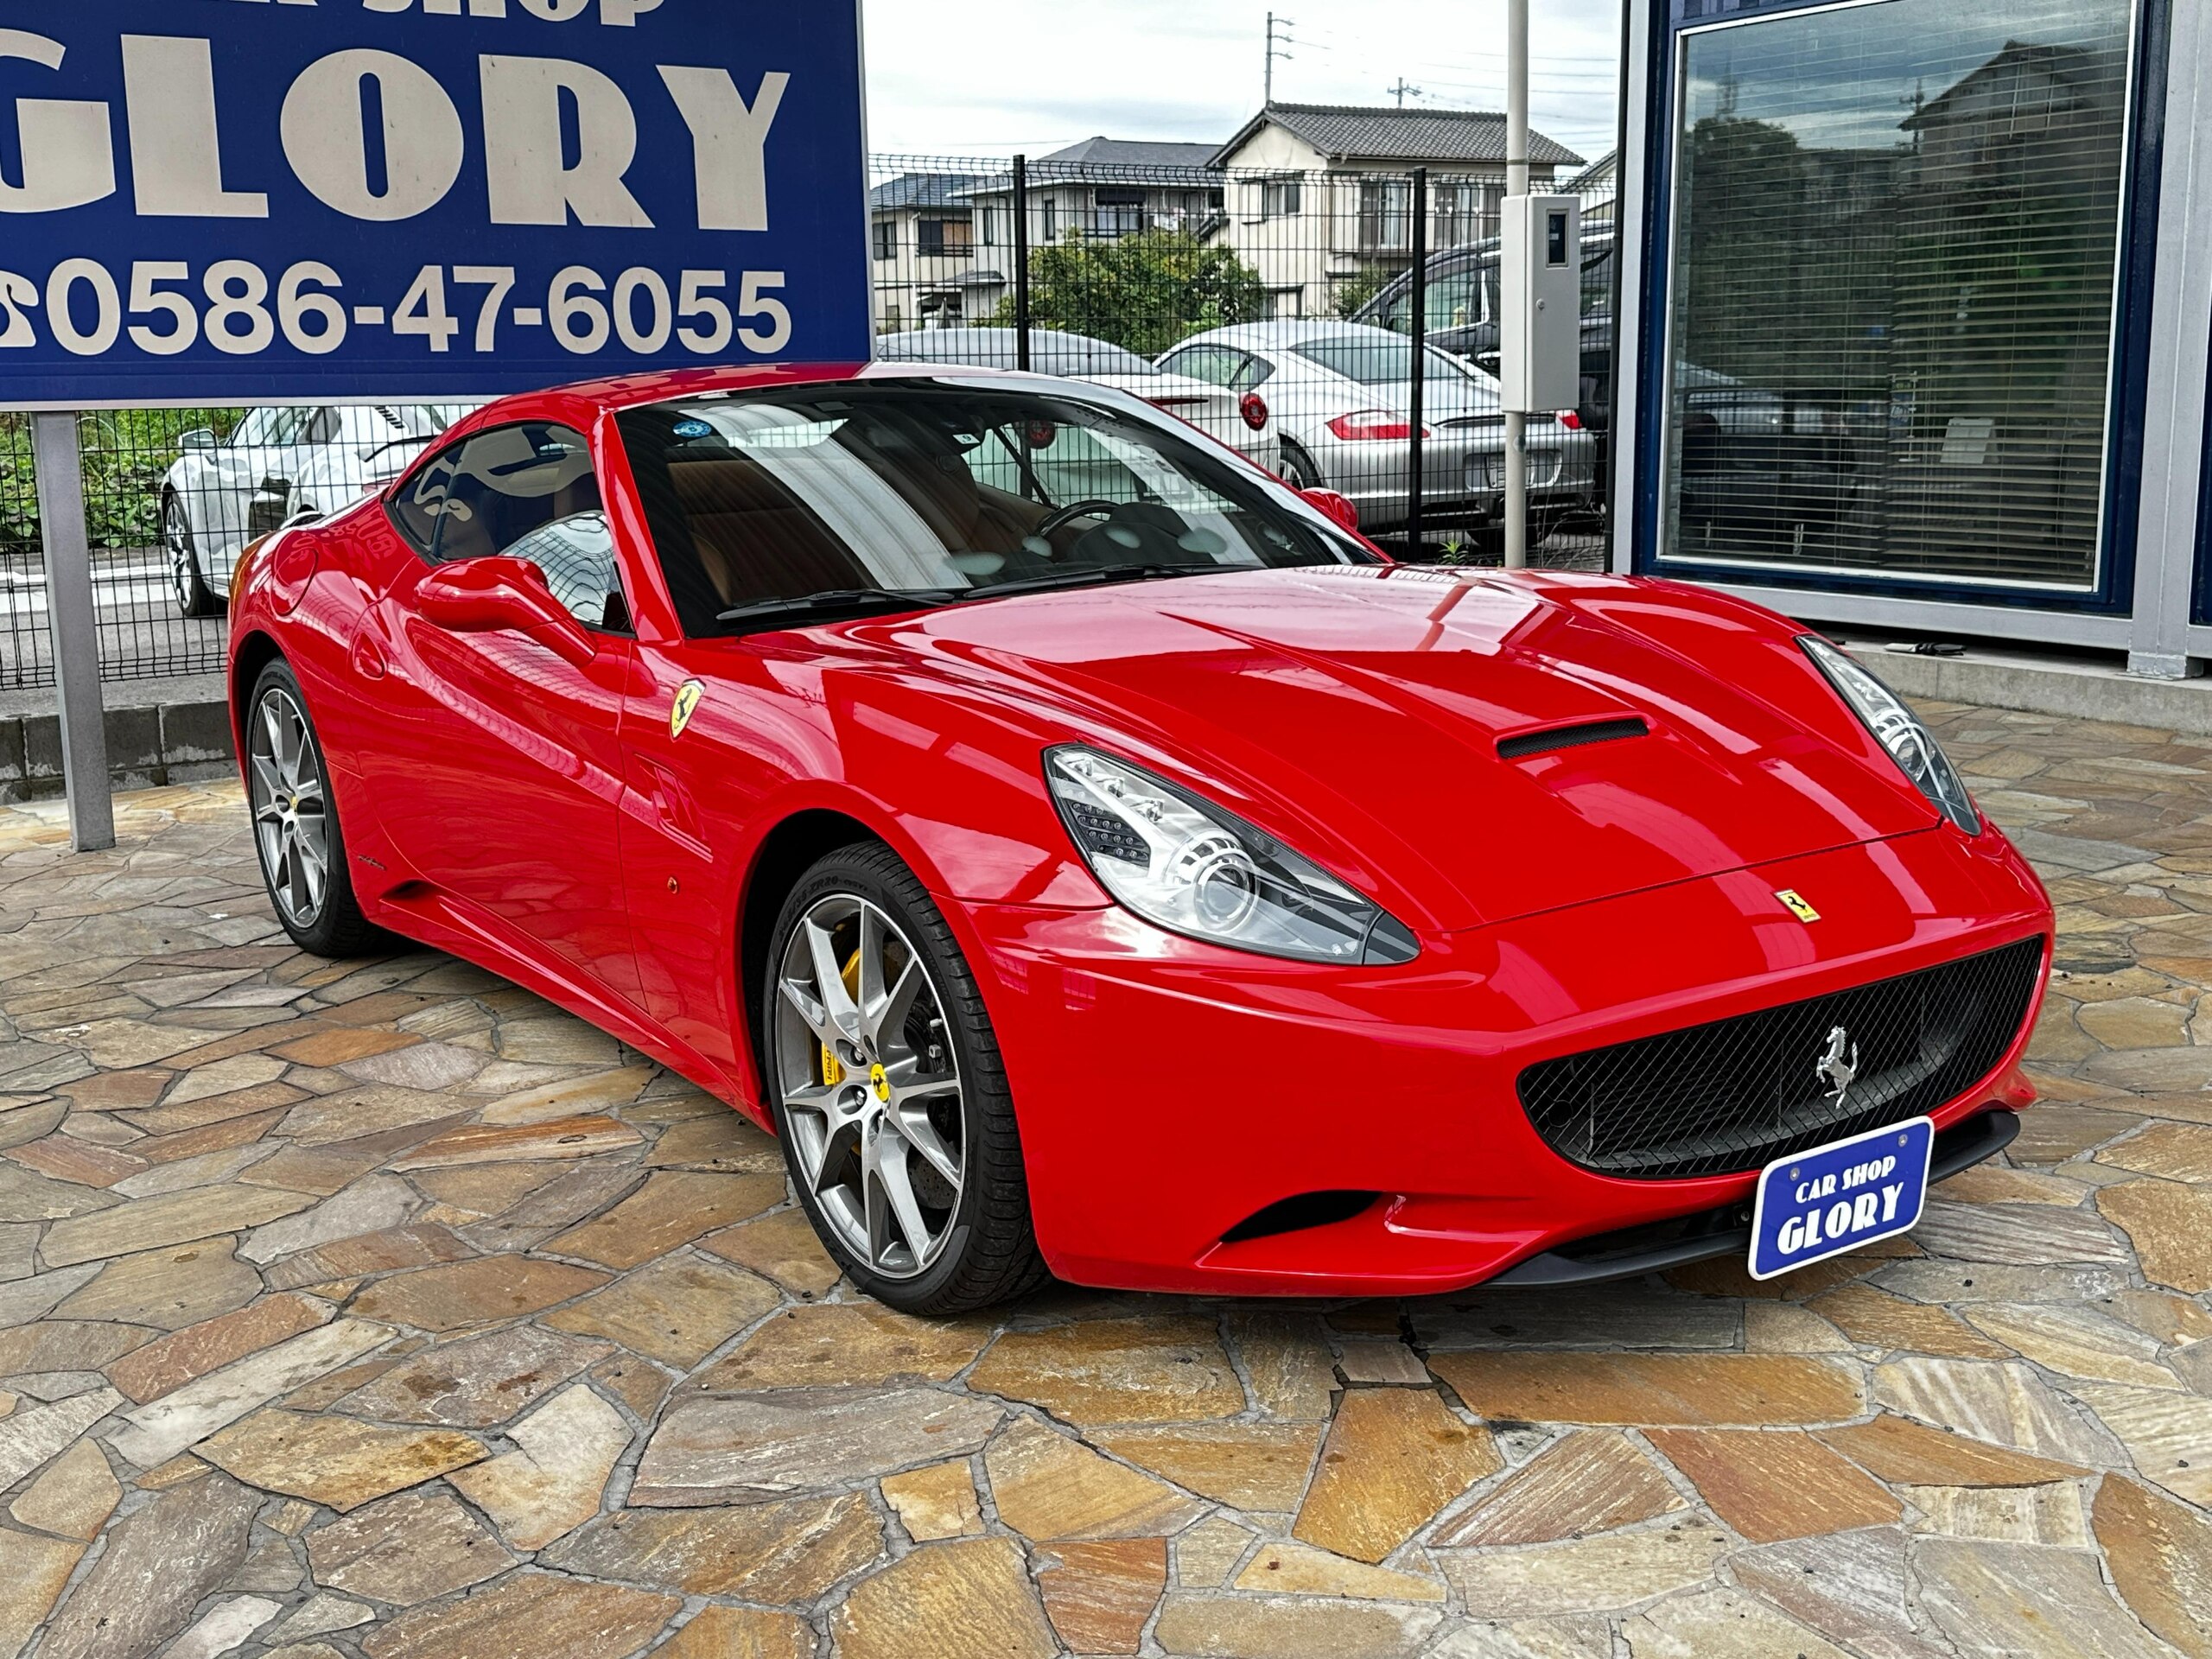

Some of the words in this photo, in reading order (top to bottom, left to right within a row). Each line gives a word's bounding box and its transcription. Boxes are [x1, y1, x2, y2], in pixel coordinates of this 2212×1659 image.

[0, 29, 791, 232] GLORY
[47, 257, 792, 356] 0586-47-6055
[1777, 1181, 1904, 1255] GLORY
[1795, 1173, 1837, 1204] CAR
[1841, 1155, 1897, 1191] SHOP
